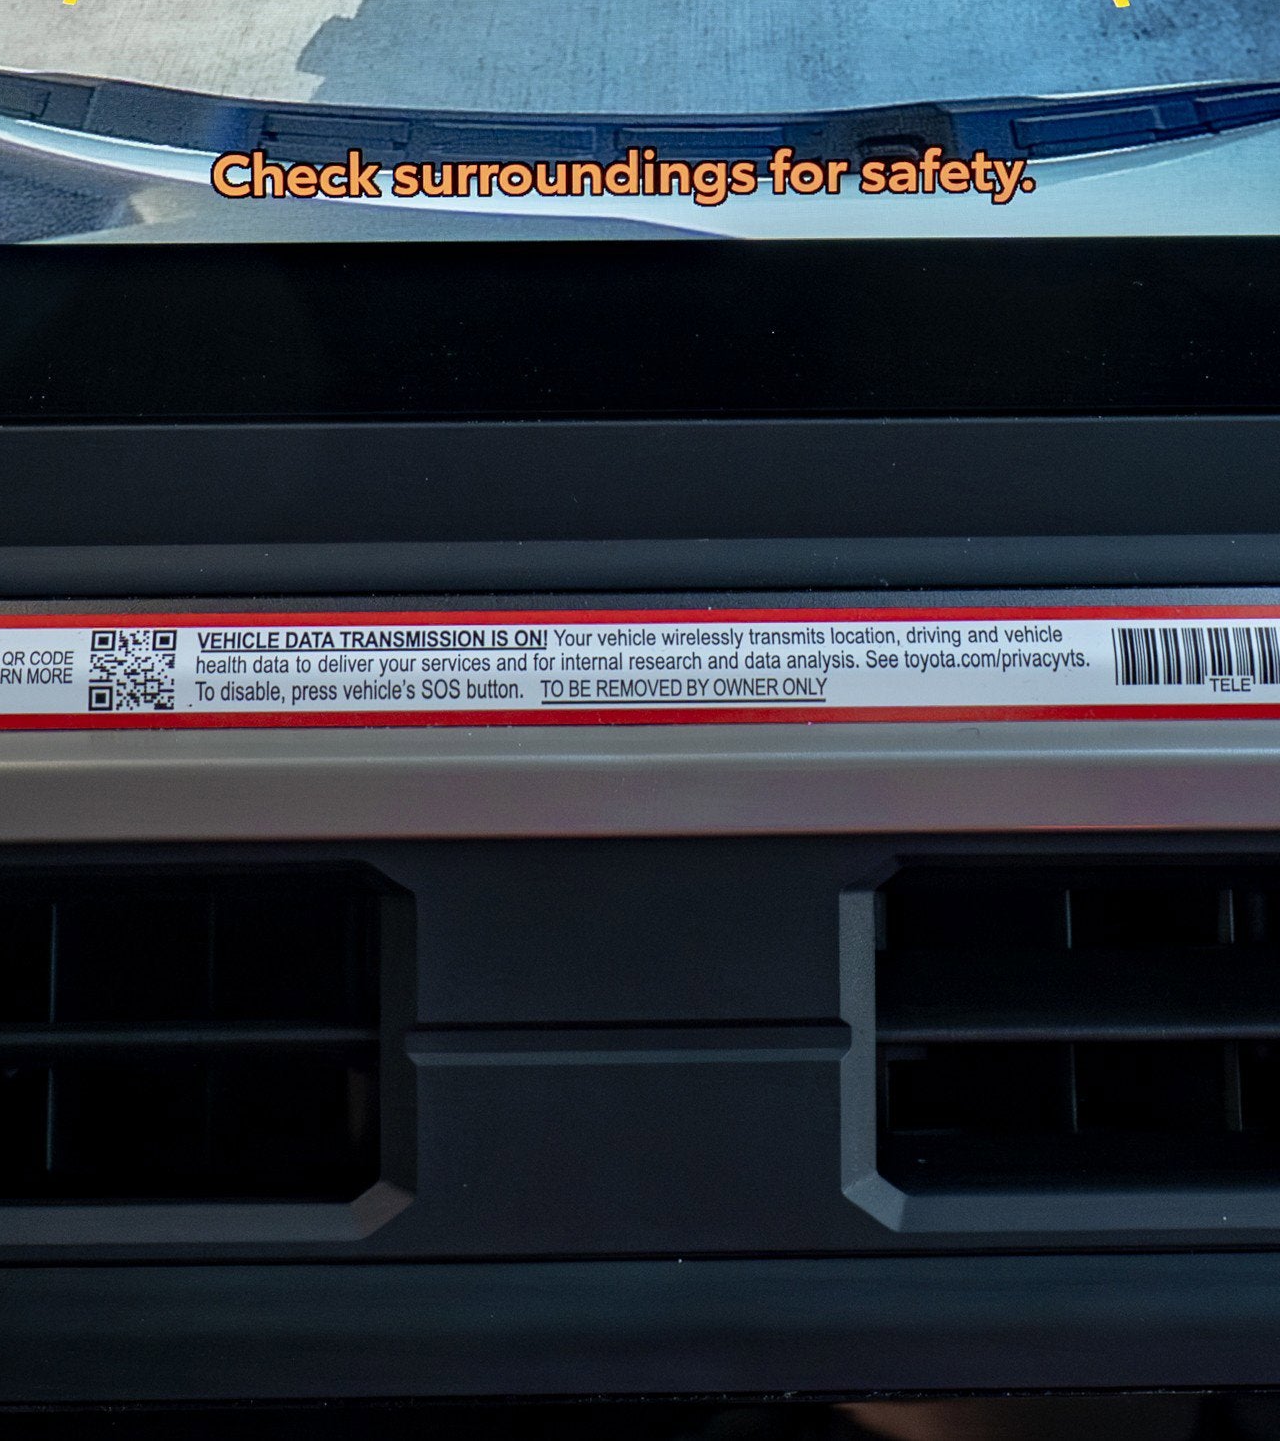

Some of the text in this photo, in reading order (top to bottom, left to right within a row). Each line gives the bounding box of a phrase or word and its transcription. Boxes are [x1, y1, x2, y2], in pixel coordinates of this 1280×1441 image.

[211, 146, 1036, 205] Check surroundings for safety.
[197, 625, 1063, 650] VEHICLE DATA TRANSMISSION IS ON! Your vehicle wirelessly transmits location, driving and vehicle
[1, 651, 26, 666] QR
[29, 650, 75, 666] CODE
[196, 648, 1090, 678] health data to deliver your services and for internal research and data analysis. See toyota.com/privacyvts.
[26, 667, 73, 684] MORE
[1209, 677, 1252, 692] TELE
[196, 677, 828, 705] To disable, press vehicle’s SOS button. TO BE REMOVED BY OWNER ONLY
